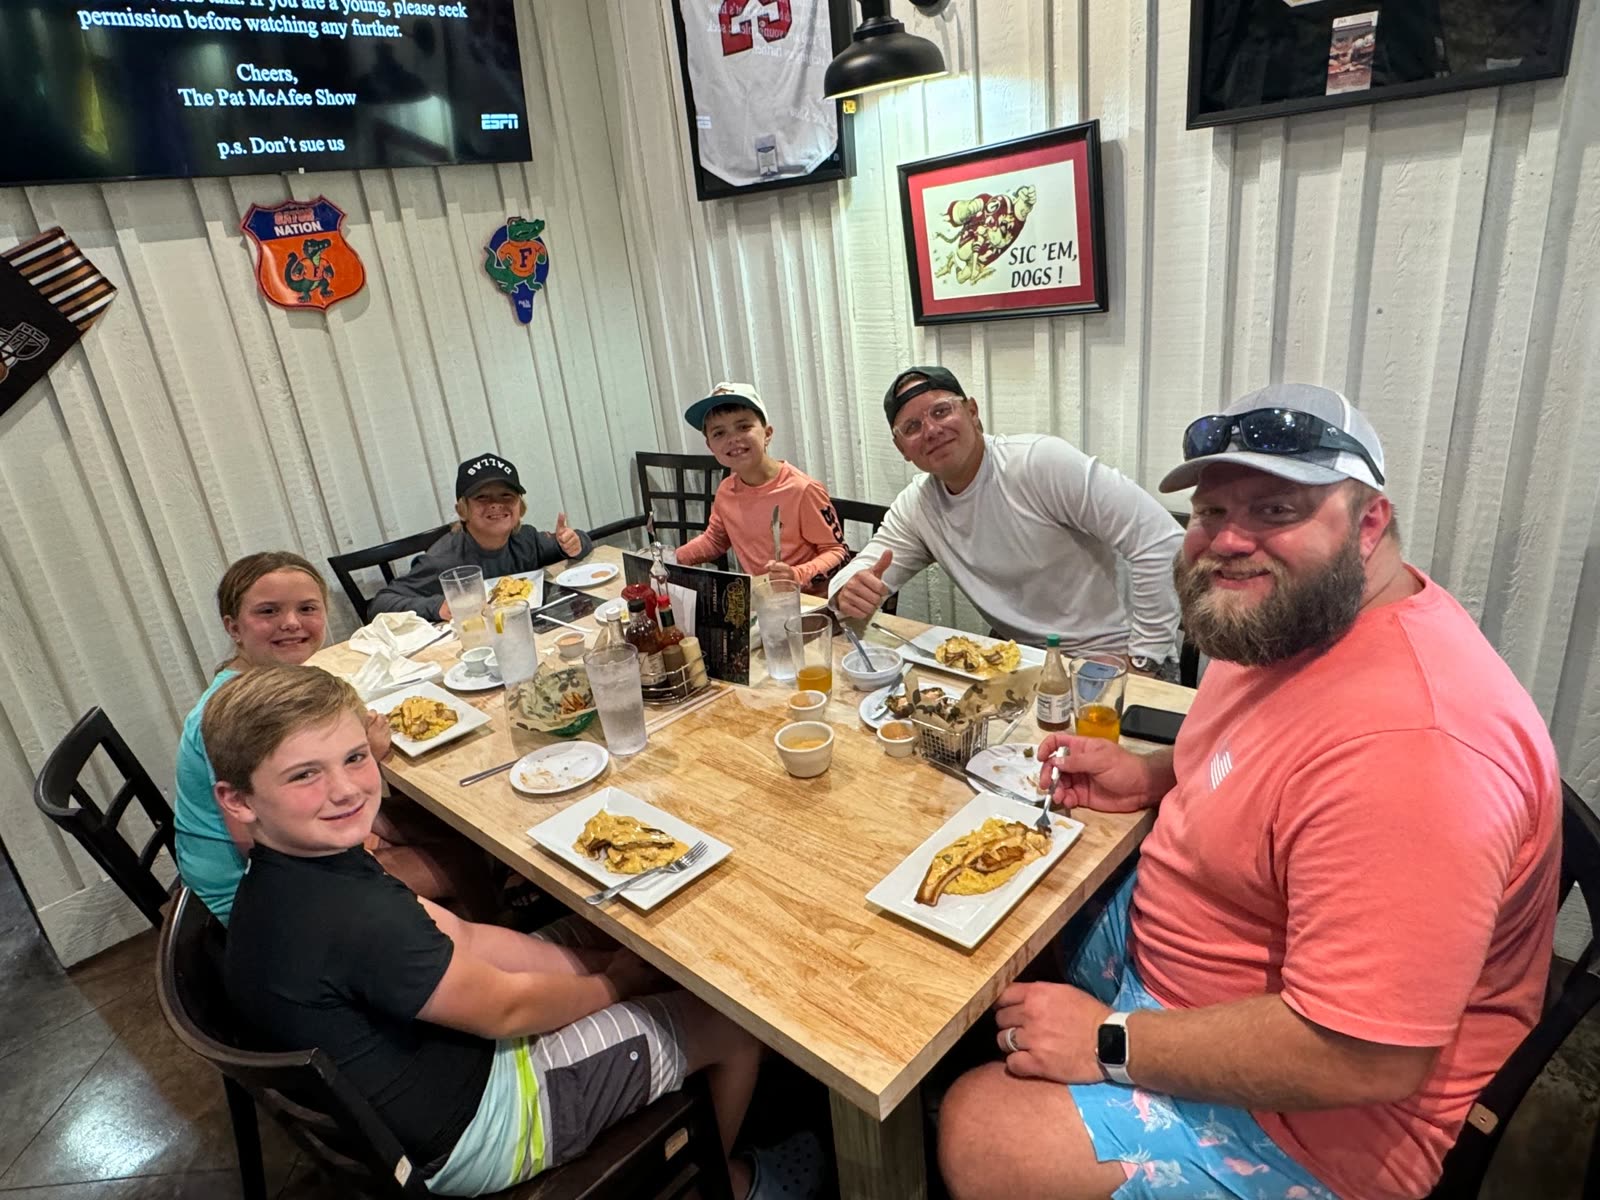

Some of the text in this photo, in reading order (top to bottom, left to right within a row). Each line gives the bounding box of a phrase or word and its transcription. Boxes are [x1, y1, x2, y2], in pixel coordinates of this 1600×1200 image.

[269, 0, 298, 11] you
[302, 0, 325, 10] are
[329, 0, 339, 10] a
[342, 0, 391, 17] young,
[393, 0, 435, 18] please
[438, 1, 468, 18] seek
[77, 7, 402, 39] permission before watching any further.
[236, 63, 298, 85] Cheers,
[177, 88, 356, 106] The Pat McAfee Show
[481, 113, 519, 130] ESPN
[217, 136, 345, 159] p.s. Don't sue us
[273, 220, 324, 237] NATION
[519, 247, 533, 268] F
[1008, 245, 1037, 266] SIC
[1011, 266, 1052, 288] DOGS
[466, 457, 513, 477] DALLAS
